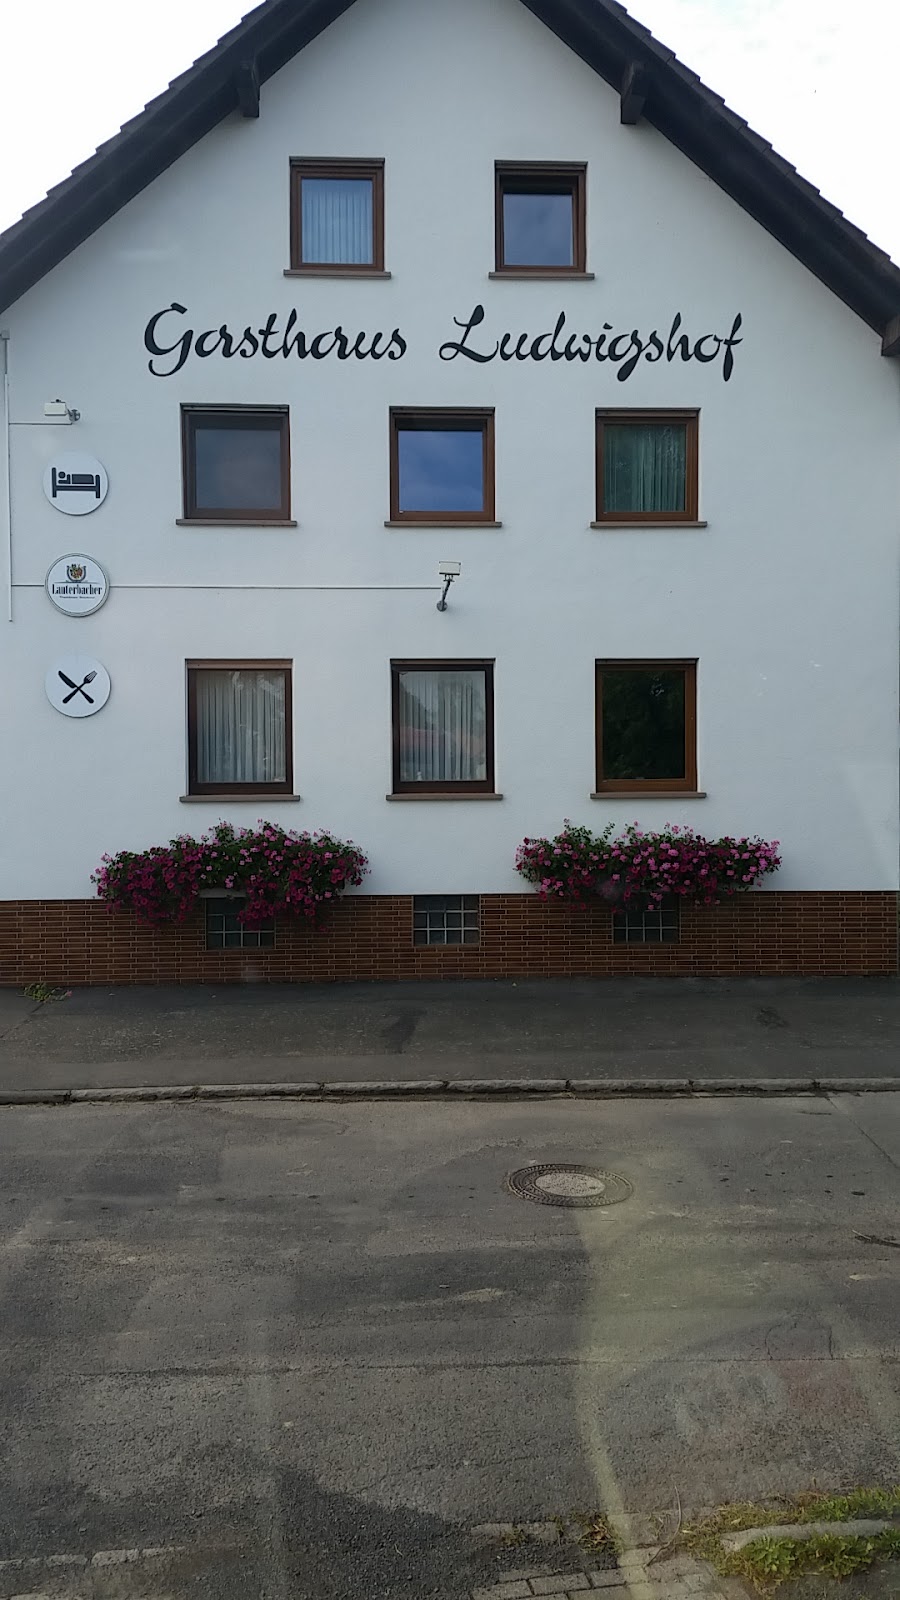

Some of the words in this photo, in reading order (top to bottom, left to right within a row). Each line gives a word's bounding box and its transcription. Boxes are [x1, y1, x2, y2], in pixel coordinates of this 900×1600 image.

[144, 302, 407, 377] Gasthaus
[439, 304, 743, 382] Ludwigshof
[52, 584, 102, 595] Lauterbacher
